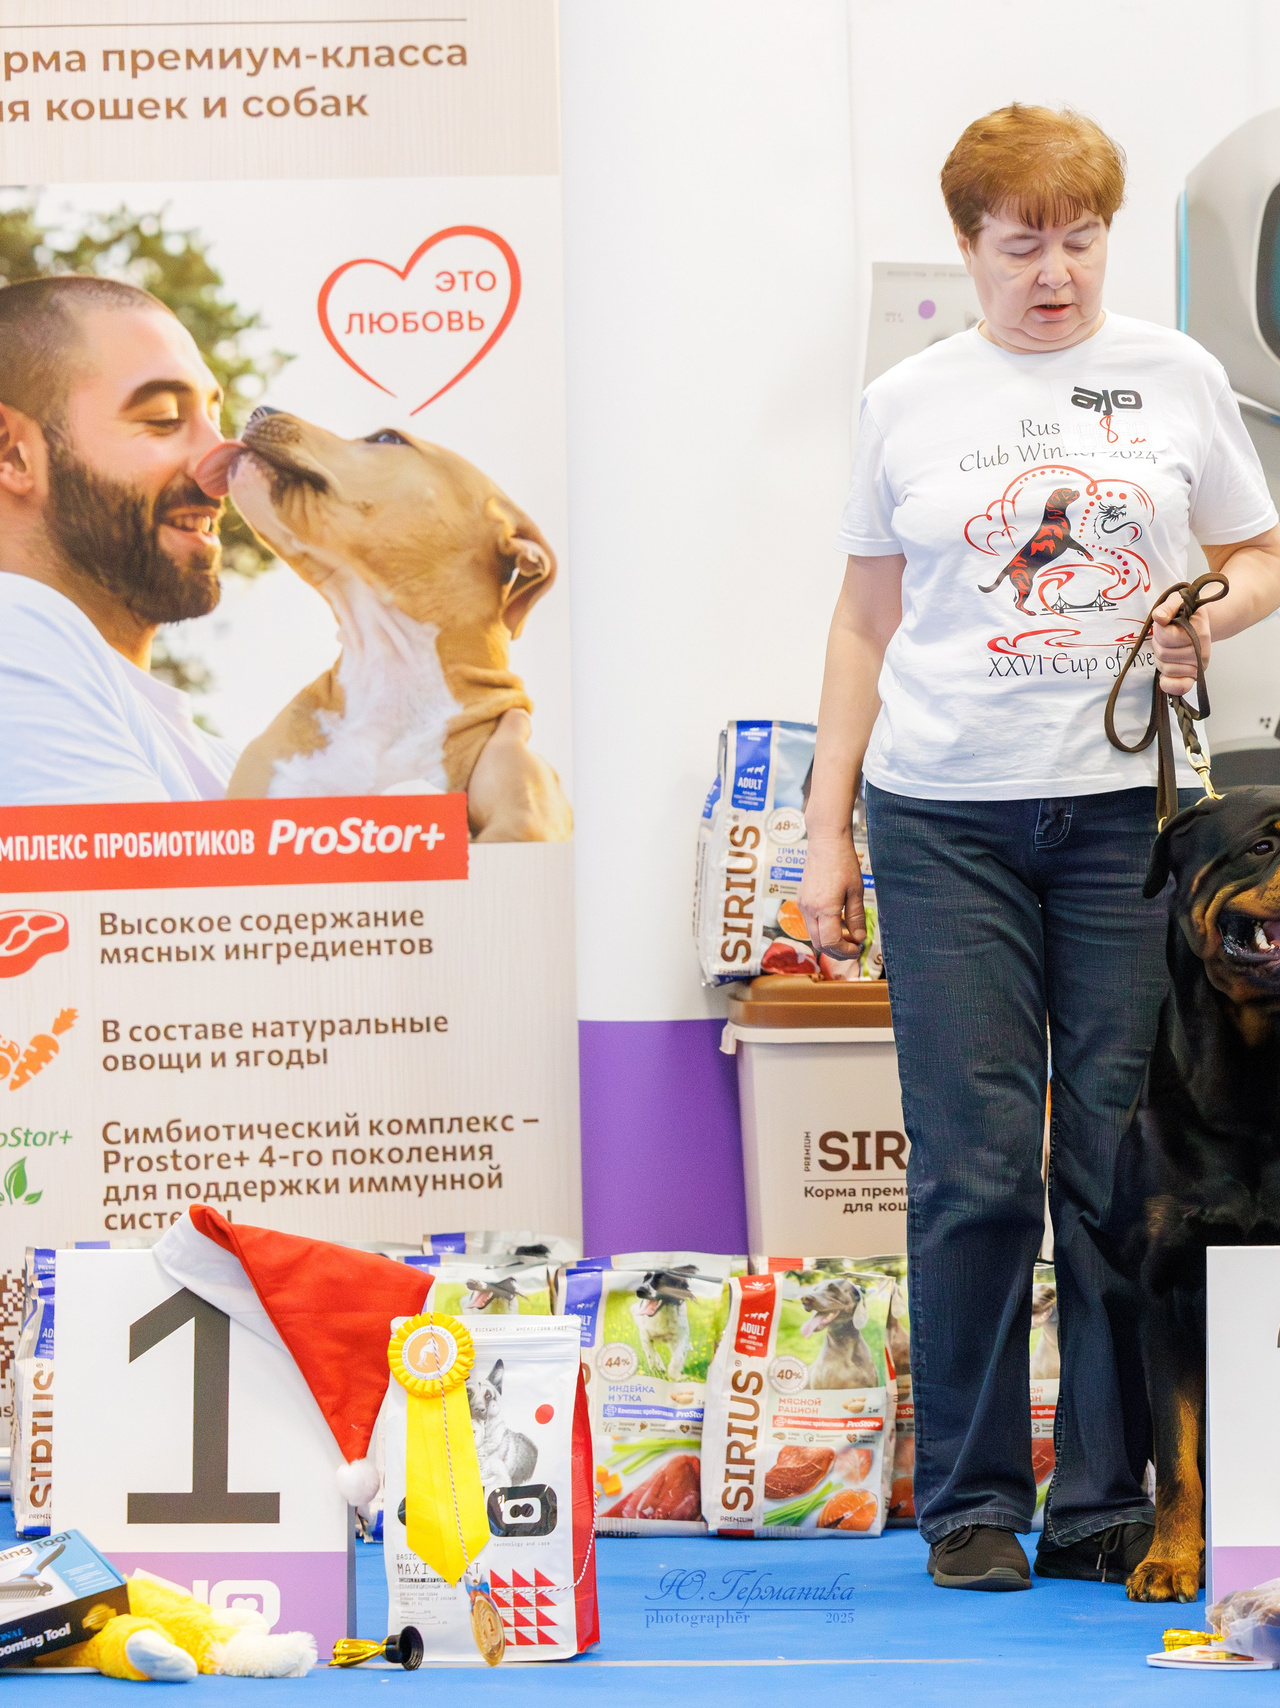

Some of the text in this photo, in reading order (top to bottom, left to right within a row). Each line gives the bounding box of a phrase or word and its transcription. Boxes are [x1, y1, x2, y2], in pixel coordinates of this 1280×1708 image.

[102, 40, 468, 77] премиум-класса
[46, 94, 189, 120] кошек
[203, 96, 227, 119] и
[241, 87, 370, 118] собак
[436, 270, 497, 292] ЭТО
[345, 310, 485, 335] ЛЮБОВЬ
[1019, 419, 1061, 438] Rus
[959, 445, 1010, 473] Club
[1015, 442, 1095, 464] Win
[988, 643, 1125, 680] XXVI Cup of
[737, 777, 764, 791] ADULT
[93, 829, 255, 859] ПРОБИОТИКОВ
[267, 816, 446, 855] ProStor+
[720, 825, 760, 964] SIRIUS
[100, 908, 425, 935] Высокое содержание
[100, 937, 433, 965] мясных ингредиентов
[102, 1015, 449, 1043] В составе натуральные
[102, 1047, 328, 1073] овощи и ягоды
[102, 1112, 515, 1145] Симбиотический комплекс
[103, 1144, 493, 1173] Prostore+ 4-го поколения
[803, 1131, 811, 1172] PREMIUM
[818, 1130, 907, 1172] SIR
[103, 1164, 503, 1207] для поддержки иммунной
[804, 1186, 856, 1200] Корма
[843, 1201, 909, 1214] для кош
[740, 1321, 766, 1336] ADULT
[604, 1356, 631, 1368] 44%
[776, 1369, 802, 1380] 40%
[608, 1384, 655, 1394] ИНДЕЙКА
[608, 1394, 642, 1402] И УТКА
[778, 1396, 822, 1406] МЯСНОЙ
[127, 1286, 280, 1524] 1
[675, 1410, 703, 1419] ProStor
[778, 1405, 820, 1415] РАЦИОН
[846, 1420, 880, 1428] ProStor+
[721, 1369, 764, 1512] SIRIUS
[33, 1531, 72, 1550] Tool
[397, 1563, 429, 1575] MAXI
[43, 1622, 72, 1641] Tool
